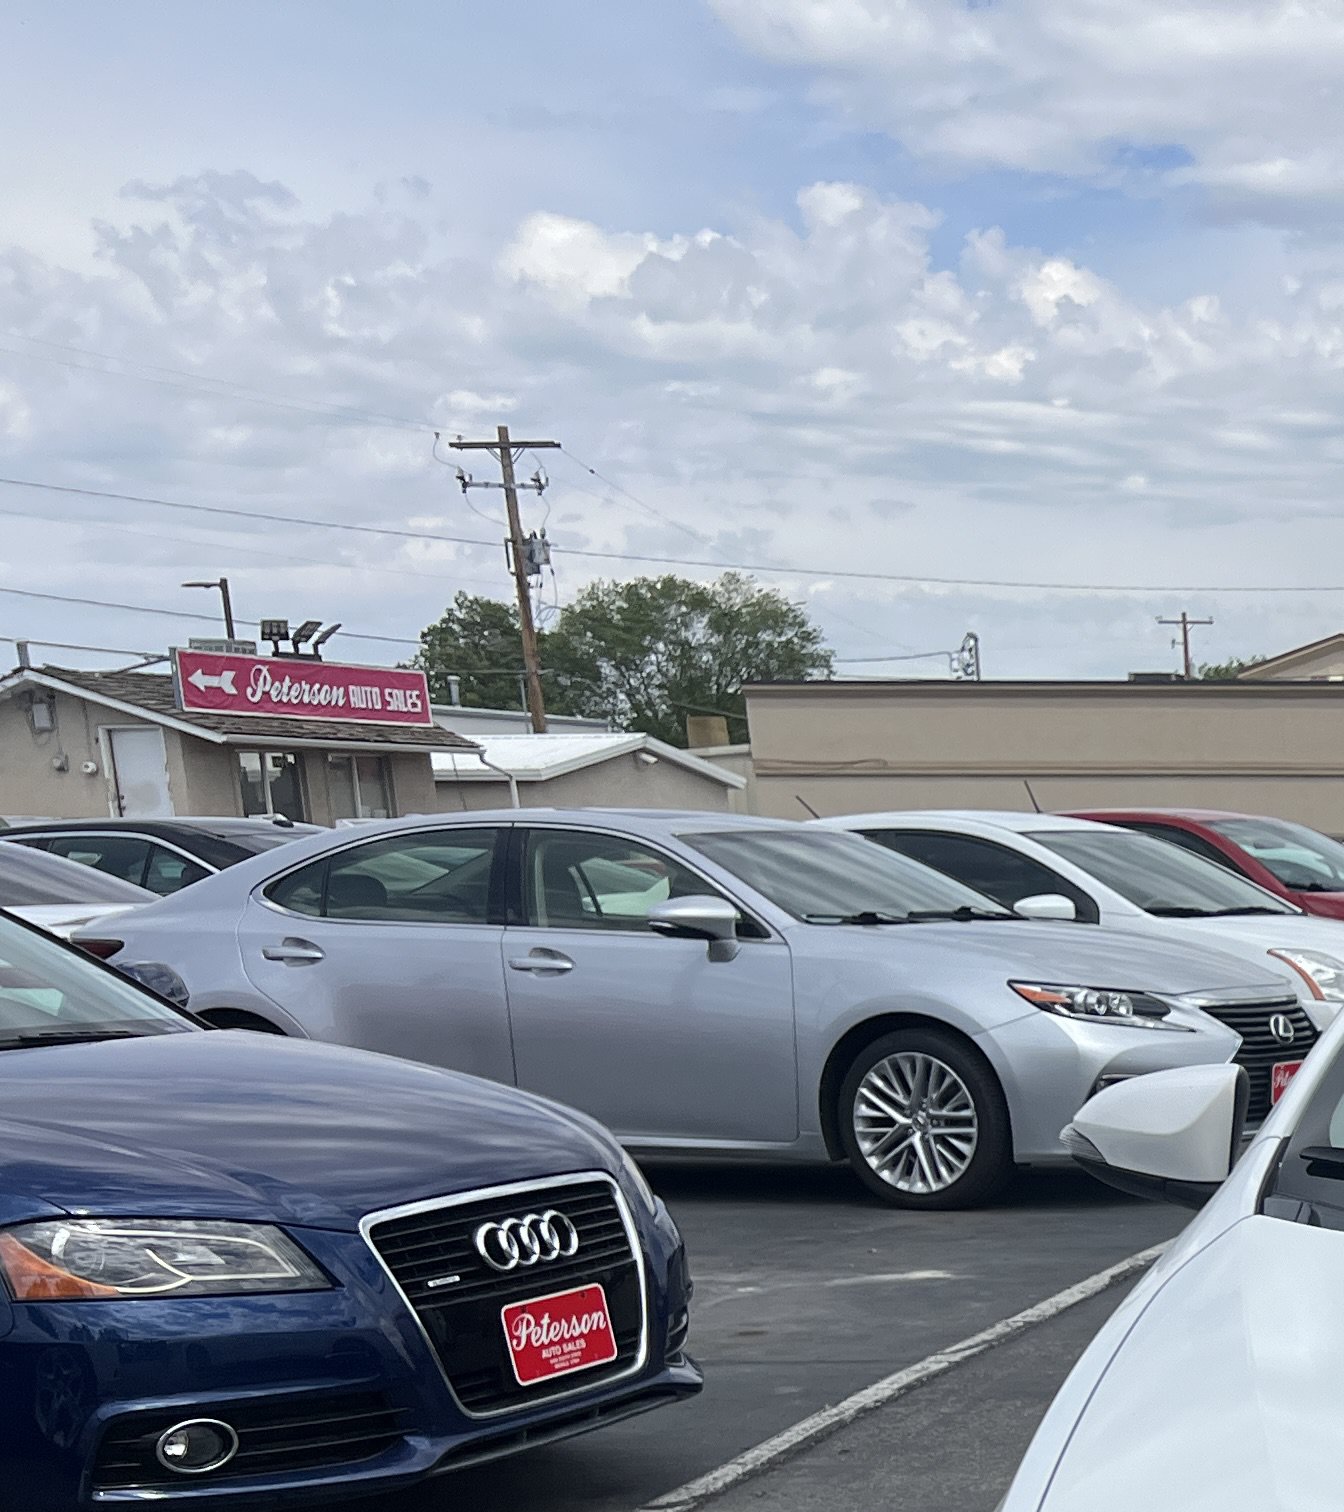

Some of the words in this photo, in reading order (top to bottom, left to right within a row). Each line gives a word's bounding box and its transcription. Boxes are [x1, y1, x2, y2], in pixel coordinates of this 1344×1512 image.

[246, 665, 346, 707] Peterson
[348, 685, 382, 709] AUTO
[384, 688, 422, 713] SALES
[512, 1310, 607, 1351] Peterson
[541, 1346, 562, 1358] AUTO
[562, 1338, 587, 1353] SALES
